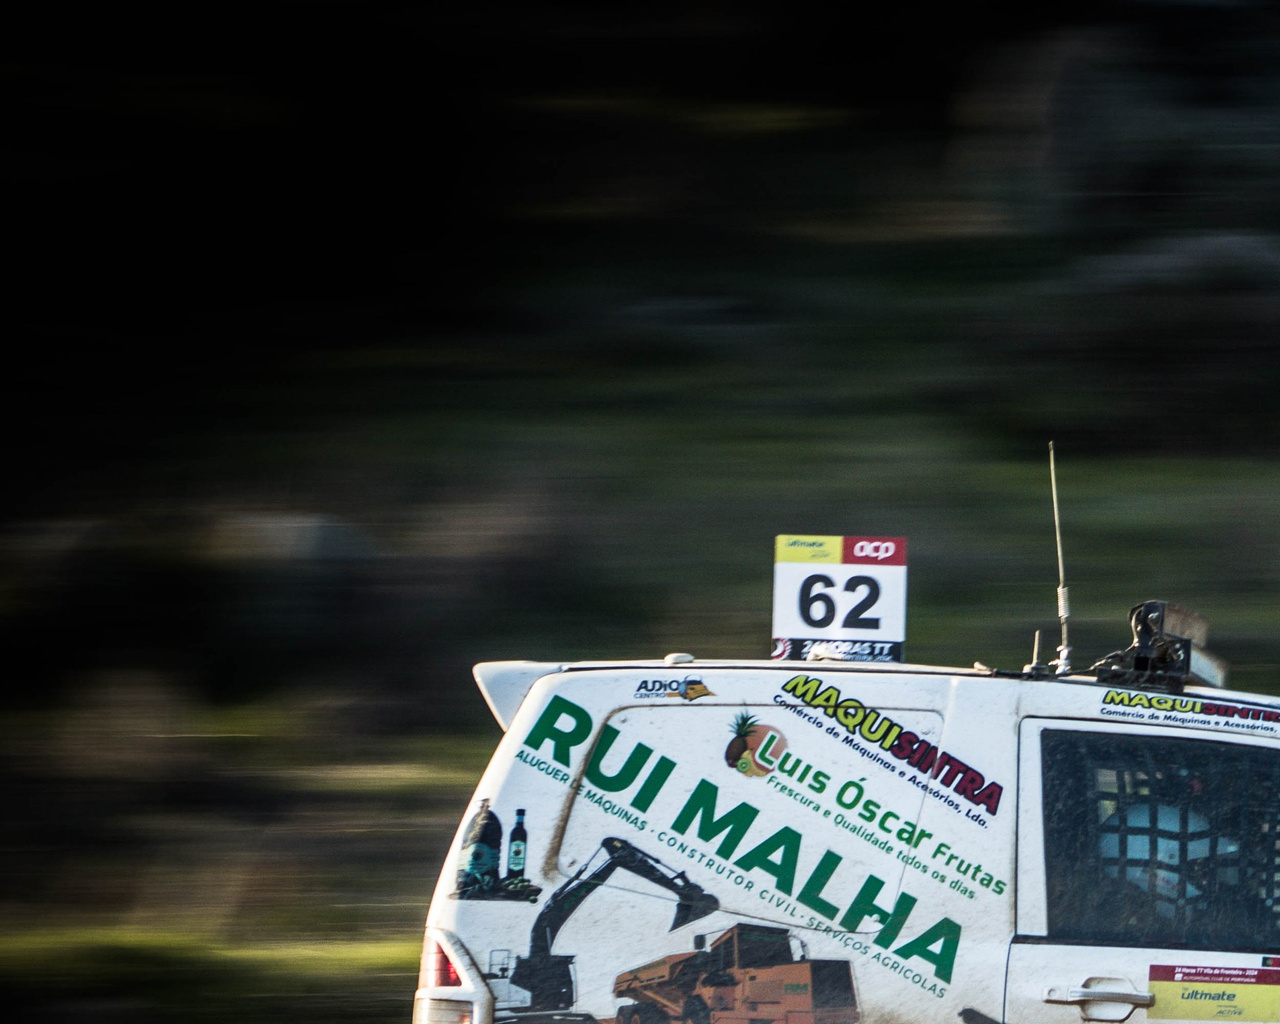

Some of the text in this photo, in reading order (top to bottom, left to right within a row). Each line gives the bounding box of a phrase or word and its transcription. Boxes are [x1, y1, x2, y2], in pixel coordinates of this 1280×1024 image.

[799, 573, 881, 629] 62
[853, 541, 896, 560] acp
[772, 694, 824, 729] Comércio
[825, 726, 841, 740] de
[841, 735, 897, 774] Máquinas
[898, 770, 907, 779] e
[965, 808, 989, 830] Lda.
[782, 674, 1004, 817] MAQUISINTRA
[1100, 707, 1145, 719] Comércio
[1147, 712, 1160, 721] de
[1163, 714, 1211, 726] Máquinas
[515, 749, 571, 784] ALUGUER
[583, 789, 648, 831] MÁQUINAS
[657, 830, 754, 892] CONSTRUTOR
[758, 889, 797, 918] CIVIL
[806, 916, 869, 956] SERVIÇOS
[871, 951, 948, 999] AGRICOLAS
[523, 694, 962, 985] RUI MALHA
[766, 775, 976, 900] Frescura e Qualidade todos os dias
[835, 777, 934, 849] Óscar
[931, 842, 1008, 896] Frutas
[1181, 989, 1237, 1002] ultimate
